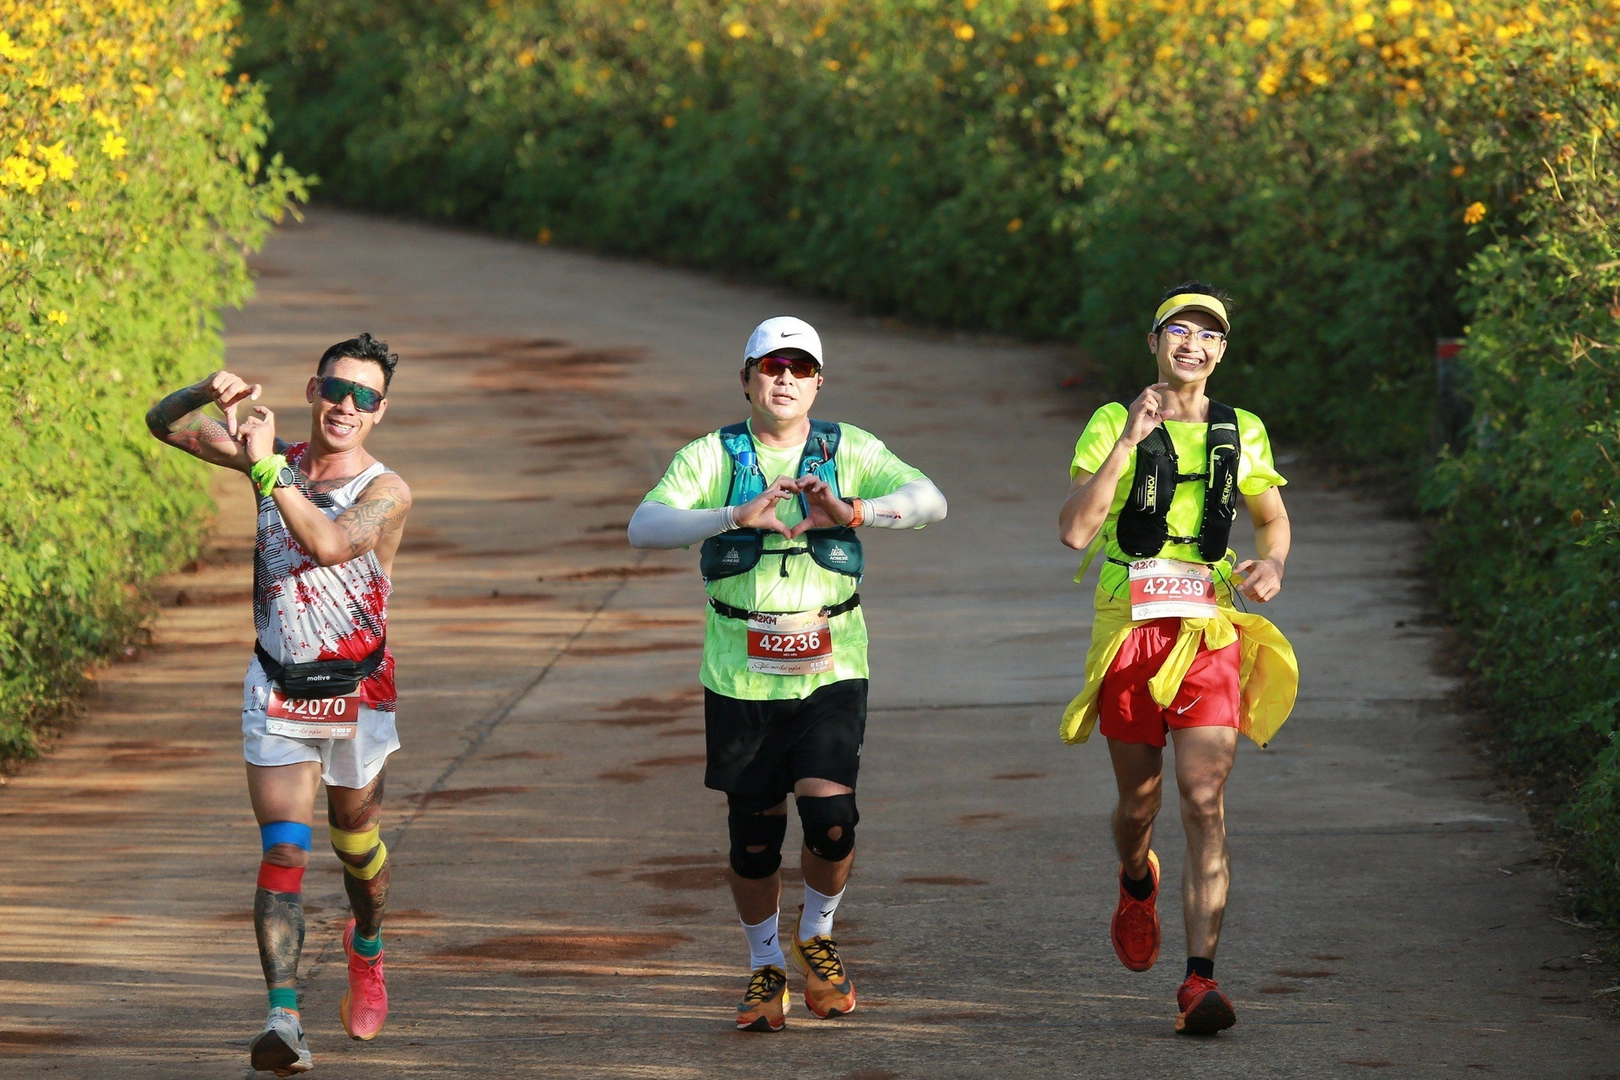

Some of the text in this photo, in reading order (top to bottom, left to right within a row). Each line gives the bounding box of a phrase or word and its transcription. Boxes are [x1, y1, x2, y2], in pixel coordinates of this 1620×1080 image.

[1143, 578, 1204, 597] 42239
[759, 632, 820, 652] 42236
[281, 698, 346, 716] 42070
